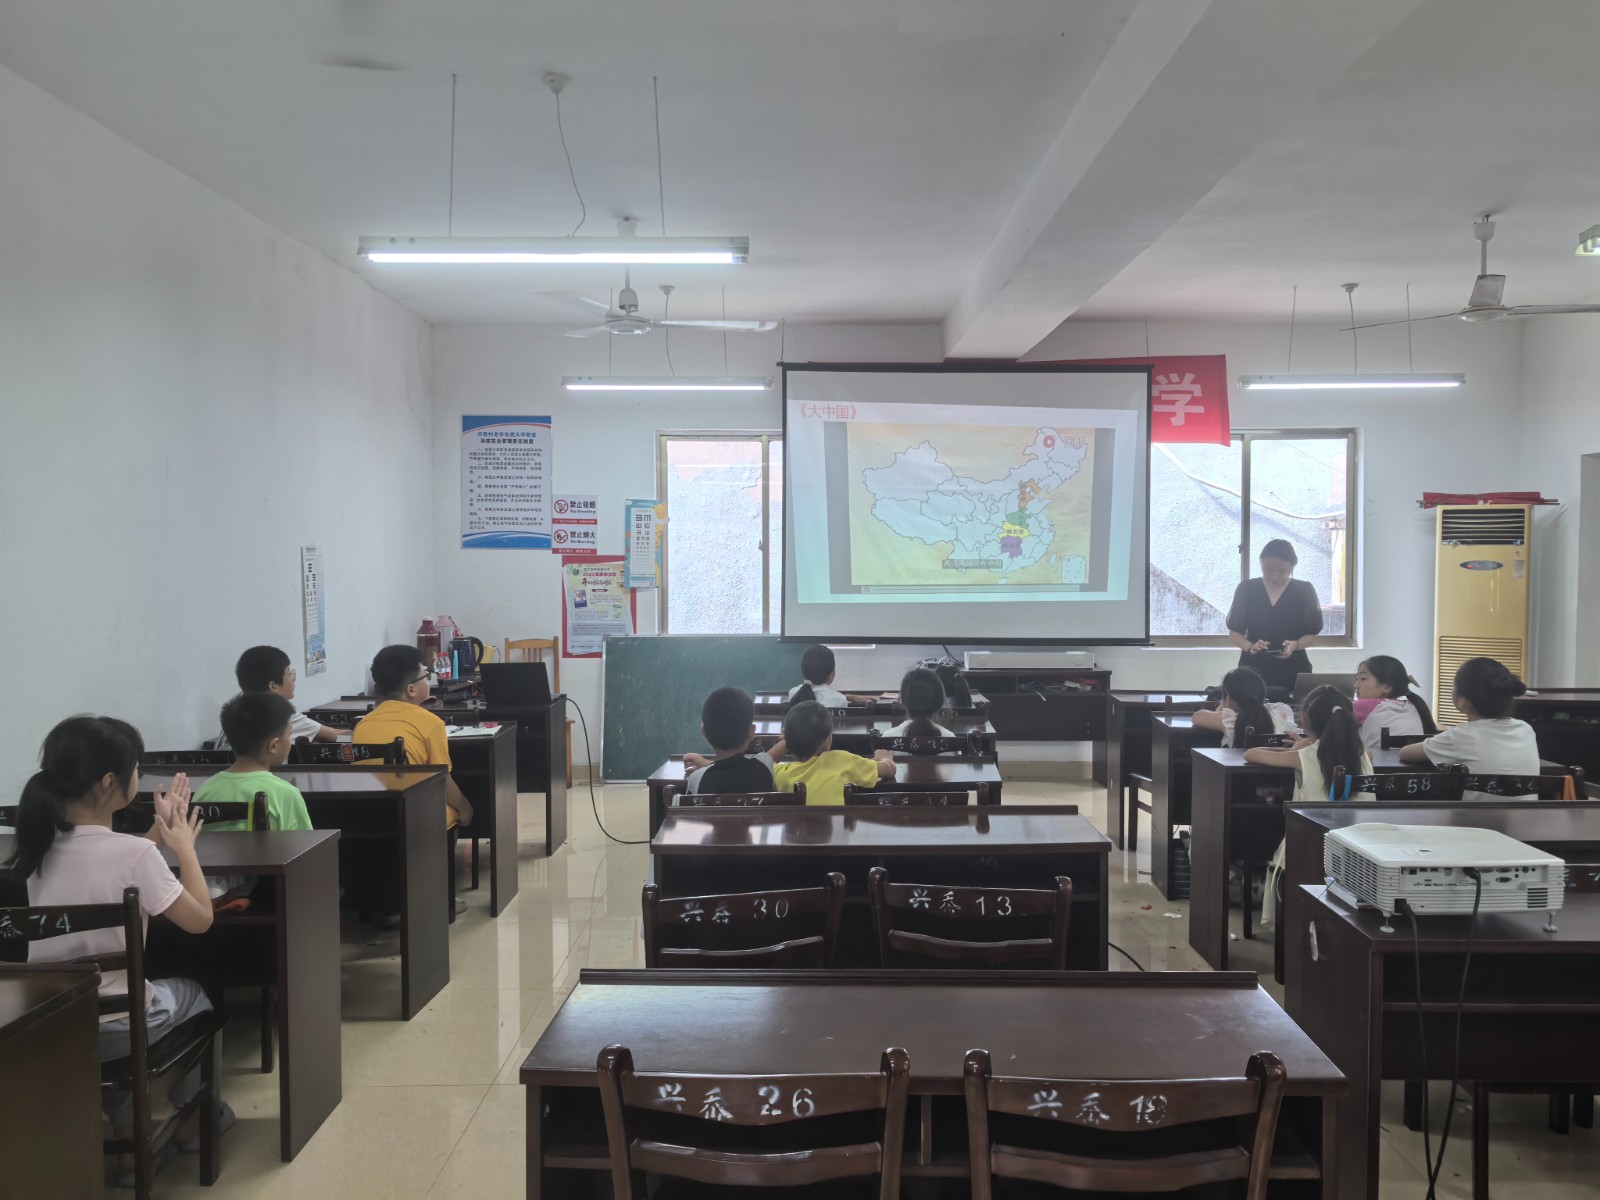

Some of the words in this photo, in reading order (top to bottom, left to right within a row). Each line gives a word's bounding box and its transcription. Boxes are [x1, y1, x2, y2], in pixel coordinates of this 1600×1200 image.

[1152, 373, 1204, 426] 学
[801, 403, 857, 419] 《大中国》
[570, 531, 596, 539] 禁止烟火
[330, 713, 348, 725] 53
[1407, 776, 1431, 793] 58
[753, 900, 789, 919] 30
[975, 896, 1012, 916] 13
[28, 912, 72, 935] 74
[758, 1085, 815, 1118] 26
